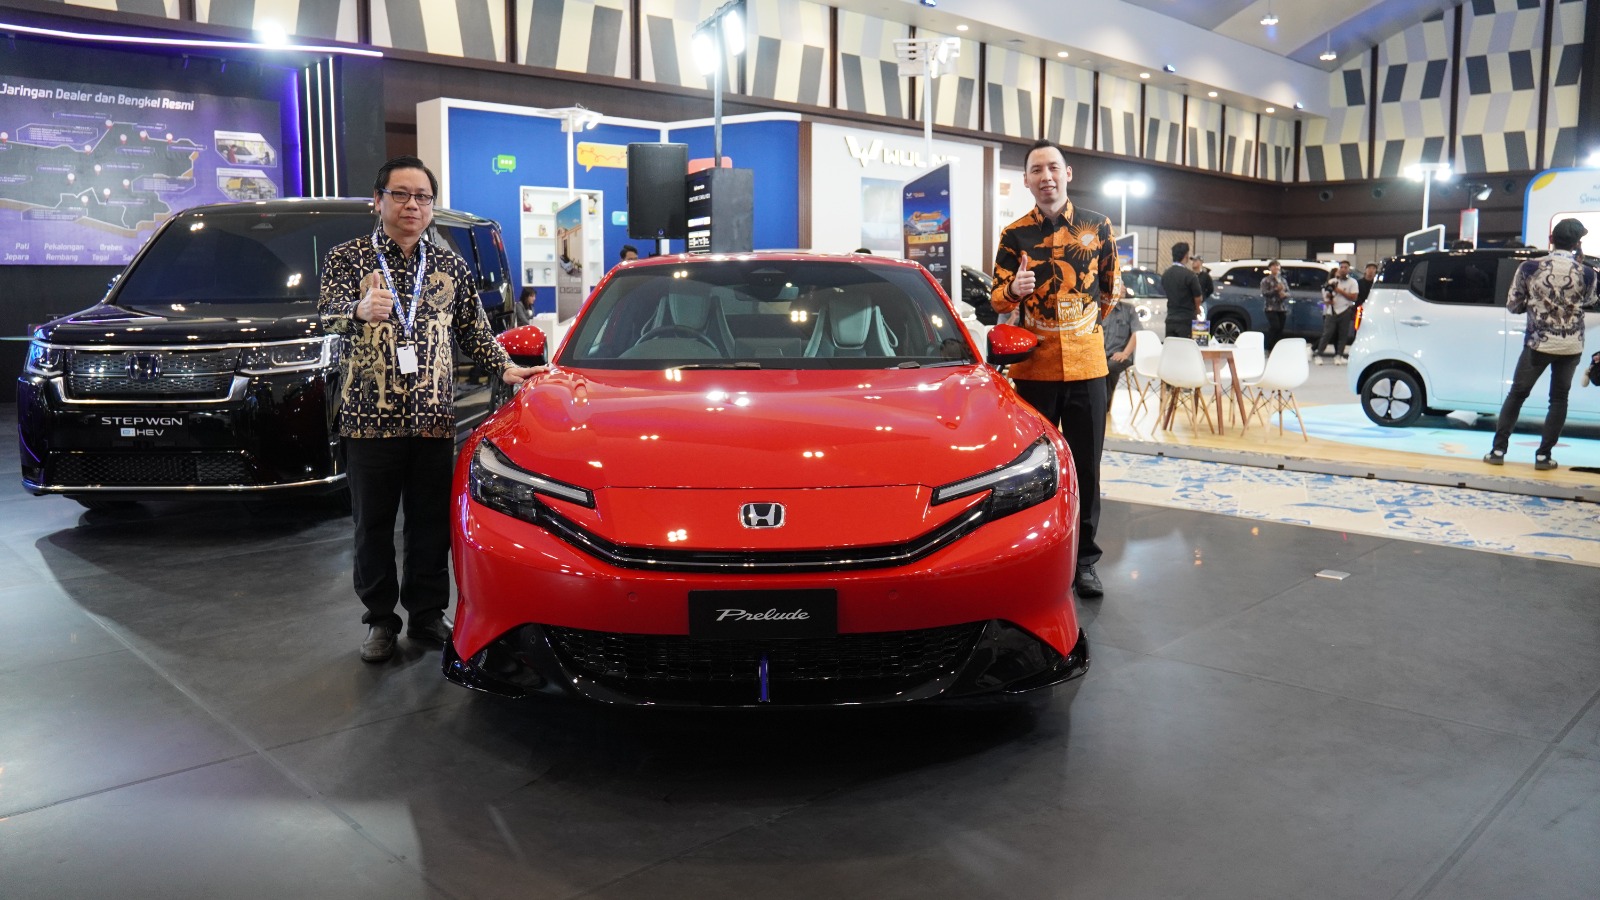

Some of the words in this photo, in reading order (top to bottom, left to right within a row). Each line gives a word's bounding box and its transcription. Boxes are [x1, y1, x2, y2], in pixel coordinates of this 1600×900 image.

[0, 83, 53, 99] Jaringan
[56, 88, 92, 102] Dealer
[95, 92, 115, 104] dan
[118, 94, 160, 108] Bengkel
[162, 98, 195, 111] Resmi
[882, 148, 960, 168] WULN
[44, 243, 84, 252] Pekalongan
[100, 243, 122, 251] Brebes
[4, 253, 29, 261] Jepara
[46, 253, 78, 262] Rembang
[93, 253, 110, 262] Tegal
[715, 608, 810, 621] Prelude
